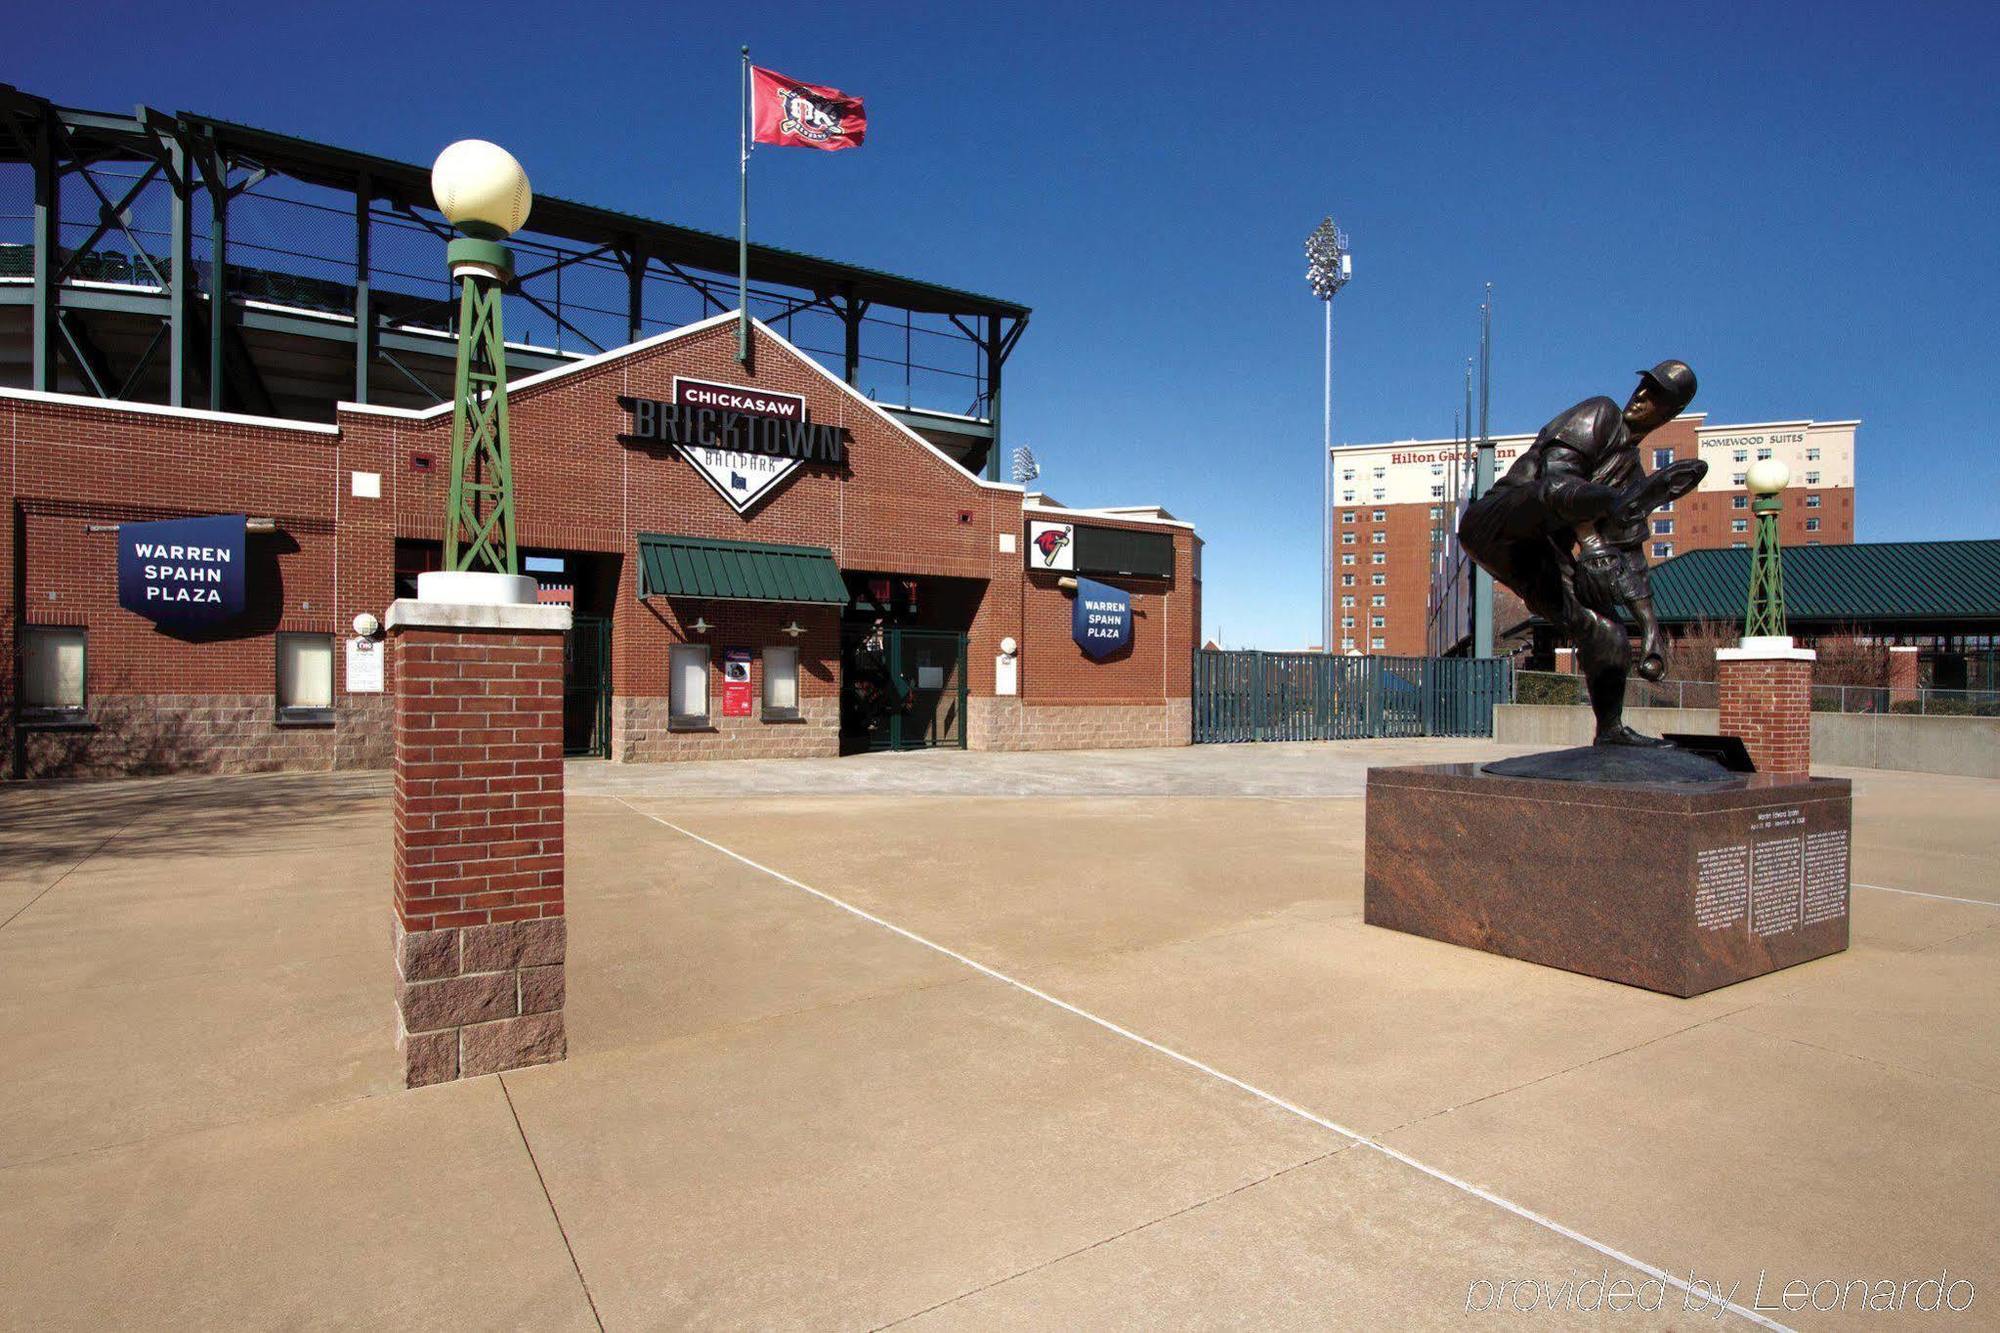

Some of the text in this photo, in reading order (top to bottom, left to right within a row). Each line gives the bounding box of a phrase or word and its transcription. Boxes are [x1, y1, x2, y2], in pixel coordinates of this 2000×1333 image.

[685, 389, 795, 416] CHICKASAW
[635, 398, 842, 462] BRICKTOWN
[1701, 433, 1803, 448] HOMEWOOD SUITES
[705, 450, 776, 473] BALLPARK
[1391, 453, 1435, 465] Hilton
[1497, 448, 1516, 458] nn
[135, 543, 231, 563] WARREN
[144, 565, 222, 583] SPAHN
[146, 586, 222, 604] PLAZA
[1085, 600, 1126, 612] WARREN
[1088, 614, 1121, 625] SPAHN
[1087, 628, 1120, 639] PLAZA
